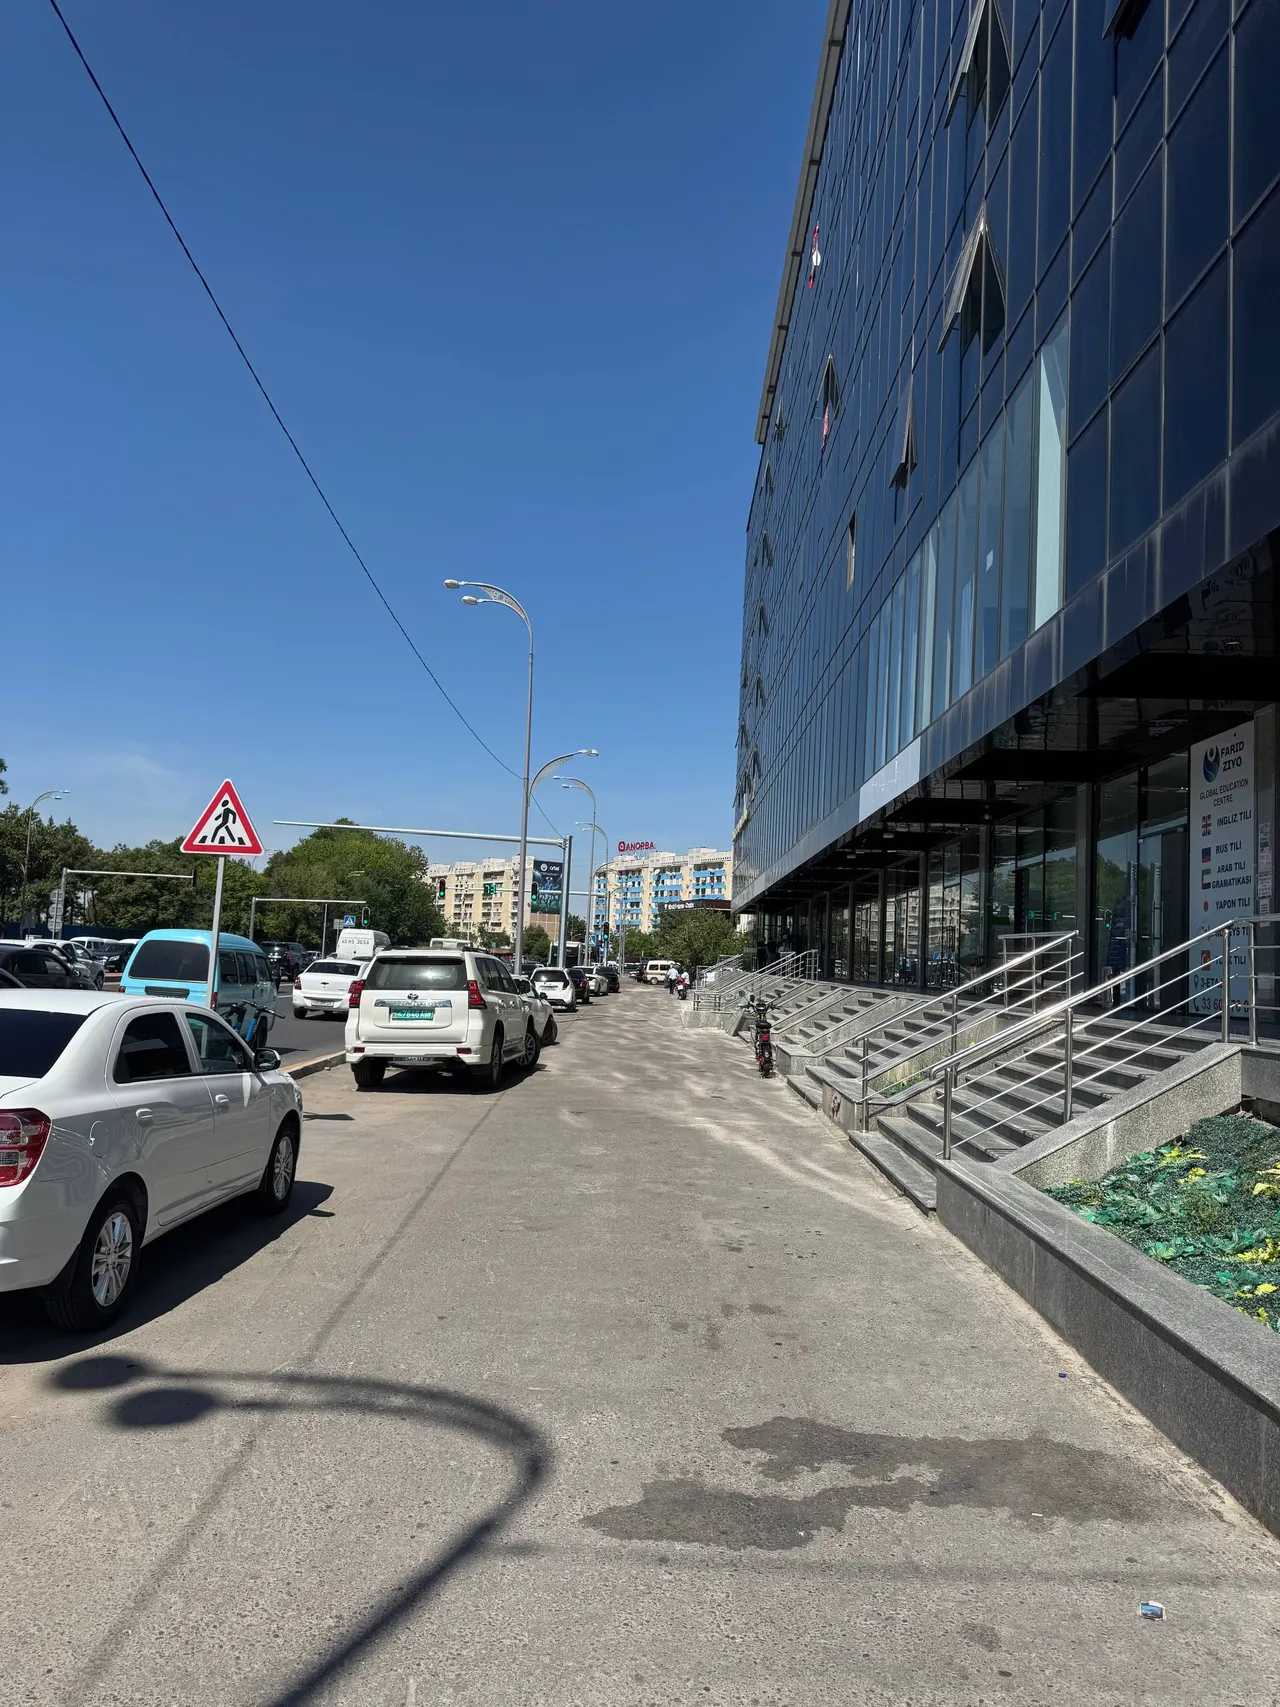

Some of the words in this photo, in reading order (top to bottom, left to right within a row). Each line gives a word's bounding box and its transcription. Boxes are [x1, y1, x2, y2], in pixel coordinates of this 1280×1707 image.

[1220, 741, 1245, 758] FARID
[1222, 756, 1242, 772] ZIYO
[1199, 787, 1219, 800] GLOBAL
[1219, 777, 1249, 794] EDUCATION
[1213, 793, 1233, 807] CENTRE
[1216, 812, 1238, 827] INGLIZ
[1239, 809, 1252, 821] TILI
[1215, 843, 1228, 855] RUS
[1229, 840, 1242, 852] TILI
[1216, 863, 1233, 874] ARAB
[1233, 860, 1246, 871] TILI
[1211, 874, 1252, 889] GRAMATIKASI
[1215, 898, 1237, 910] YAPON
[1238, 896, 1251, 907] TILI
[1233, 955, 1247, 965] TILI
[1201, 997, 1212, 1010] 33
